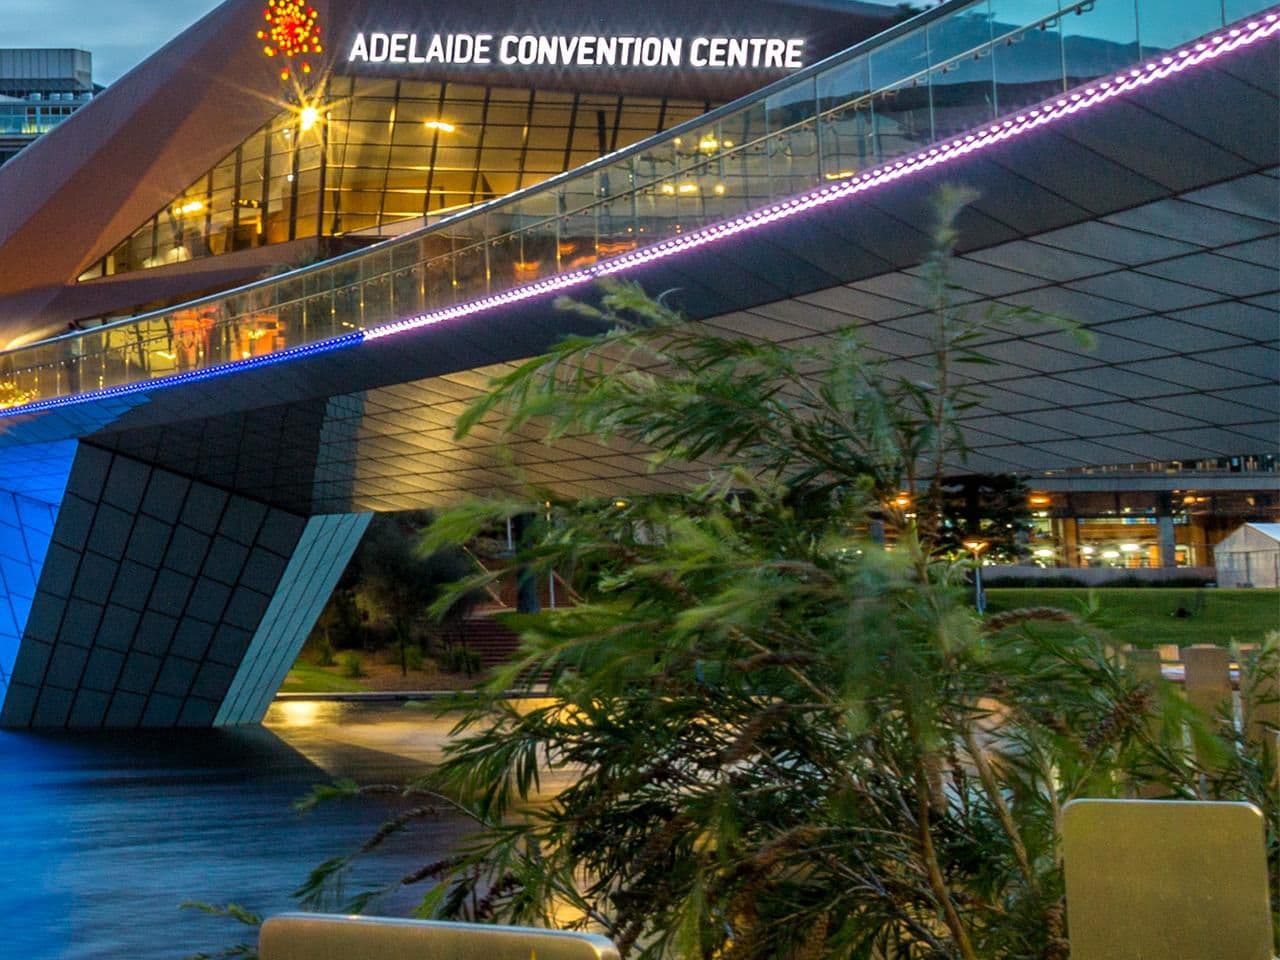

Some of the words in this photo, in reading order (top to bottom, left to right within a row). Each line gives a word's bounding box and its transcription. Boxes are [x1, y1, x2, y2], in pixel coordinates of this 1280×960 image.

[348, 32, 492, 64] ADELAIDE
[499, 35, 682, 66] CONVENTION
[690, 37, 804, 68] CENTRE
